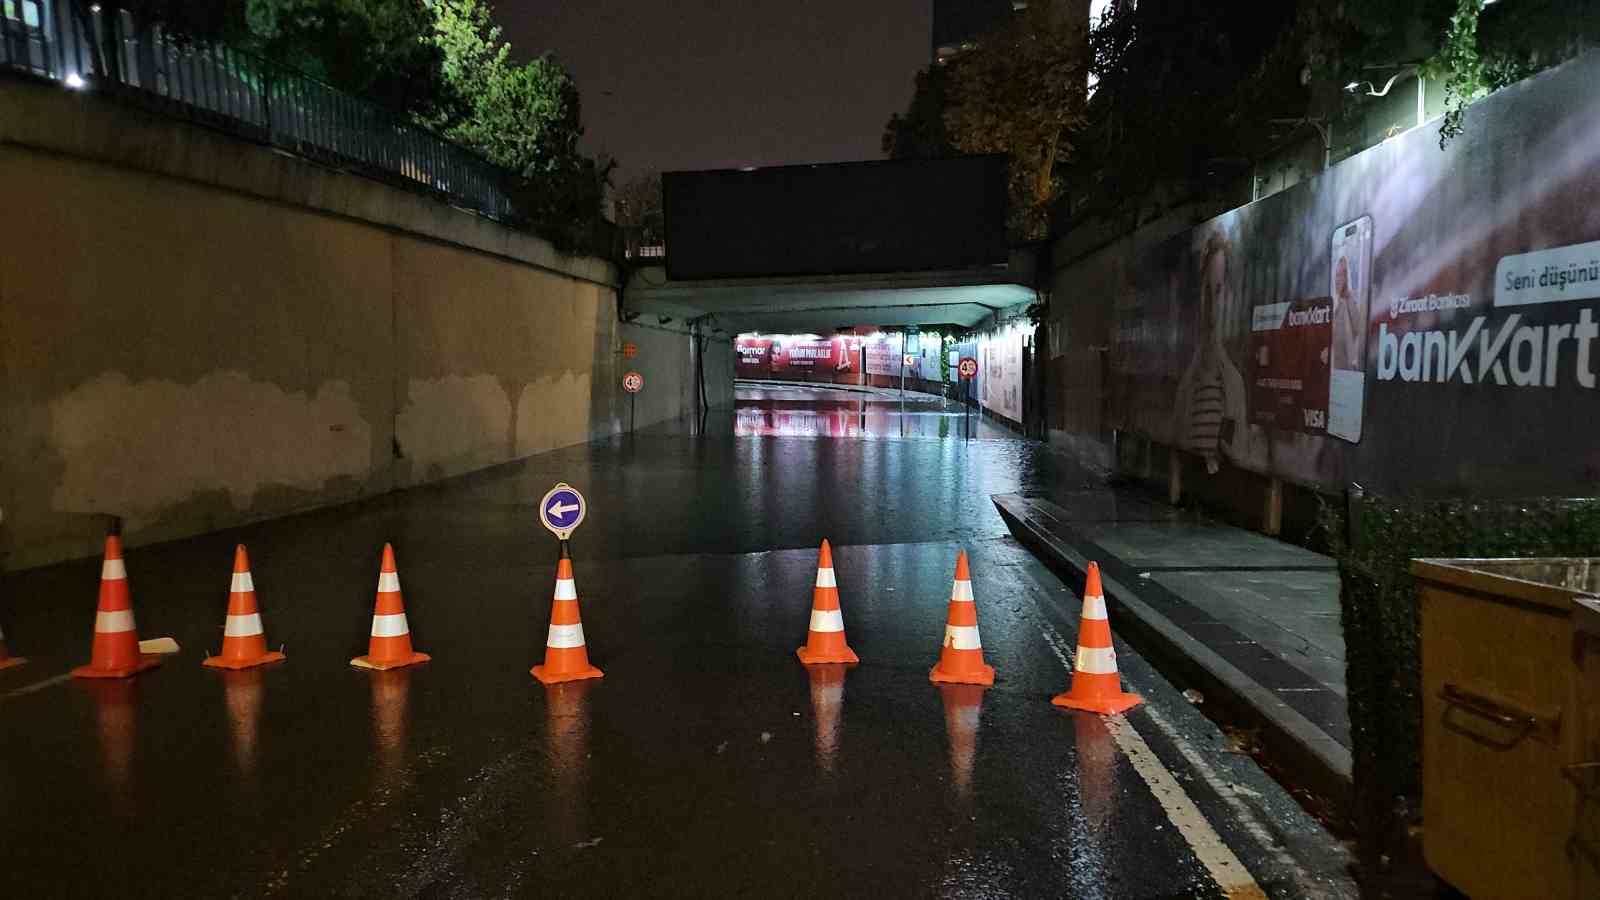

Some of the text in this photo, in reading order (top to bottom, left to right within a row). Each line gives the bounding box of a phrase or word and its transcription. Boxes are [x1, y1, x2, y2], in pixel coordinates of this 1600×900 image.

[1505, 268, 1536, 292] Seni
[1399, 296, 1428, 314] Ziraat
[1377, 308, 1600, 388] bankkart
[1303, 408, 1326, 428] VISA
